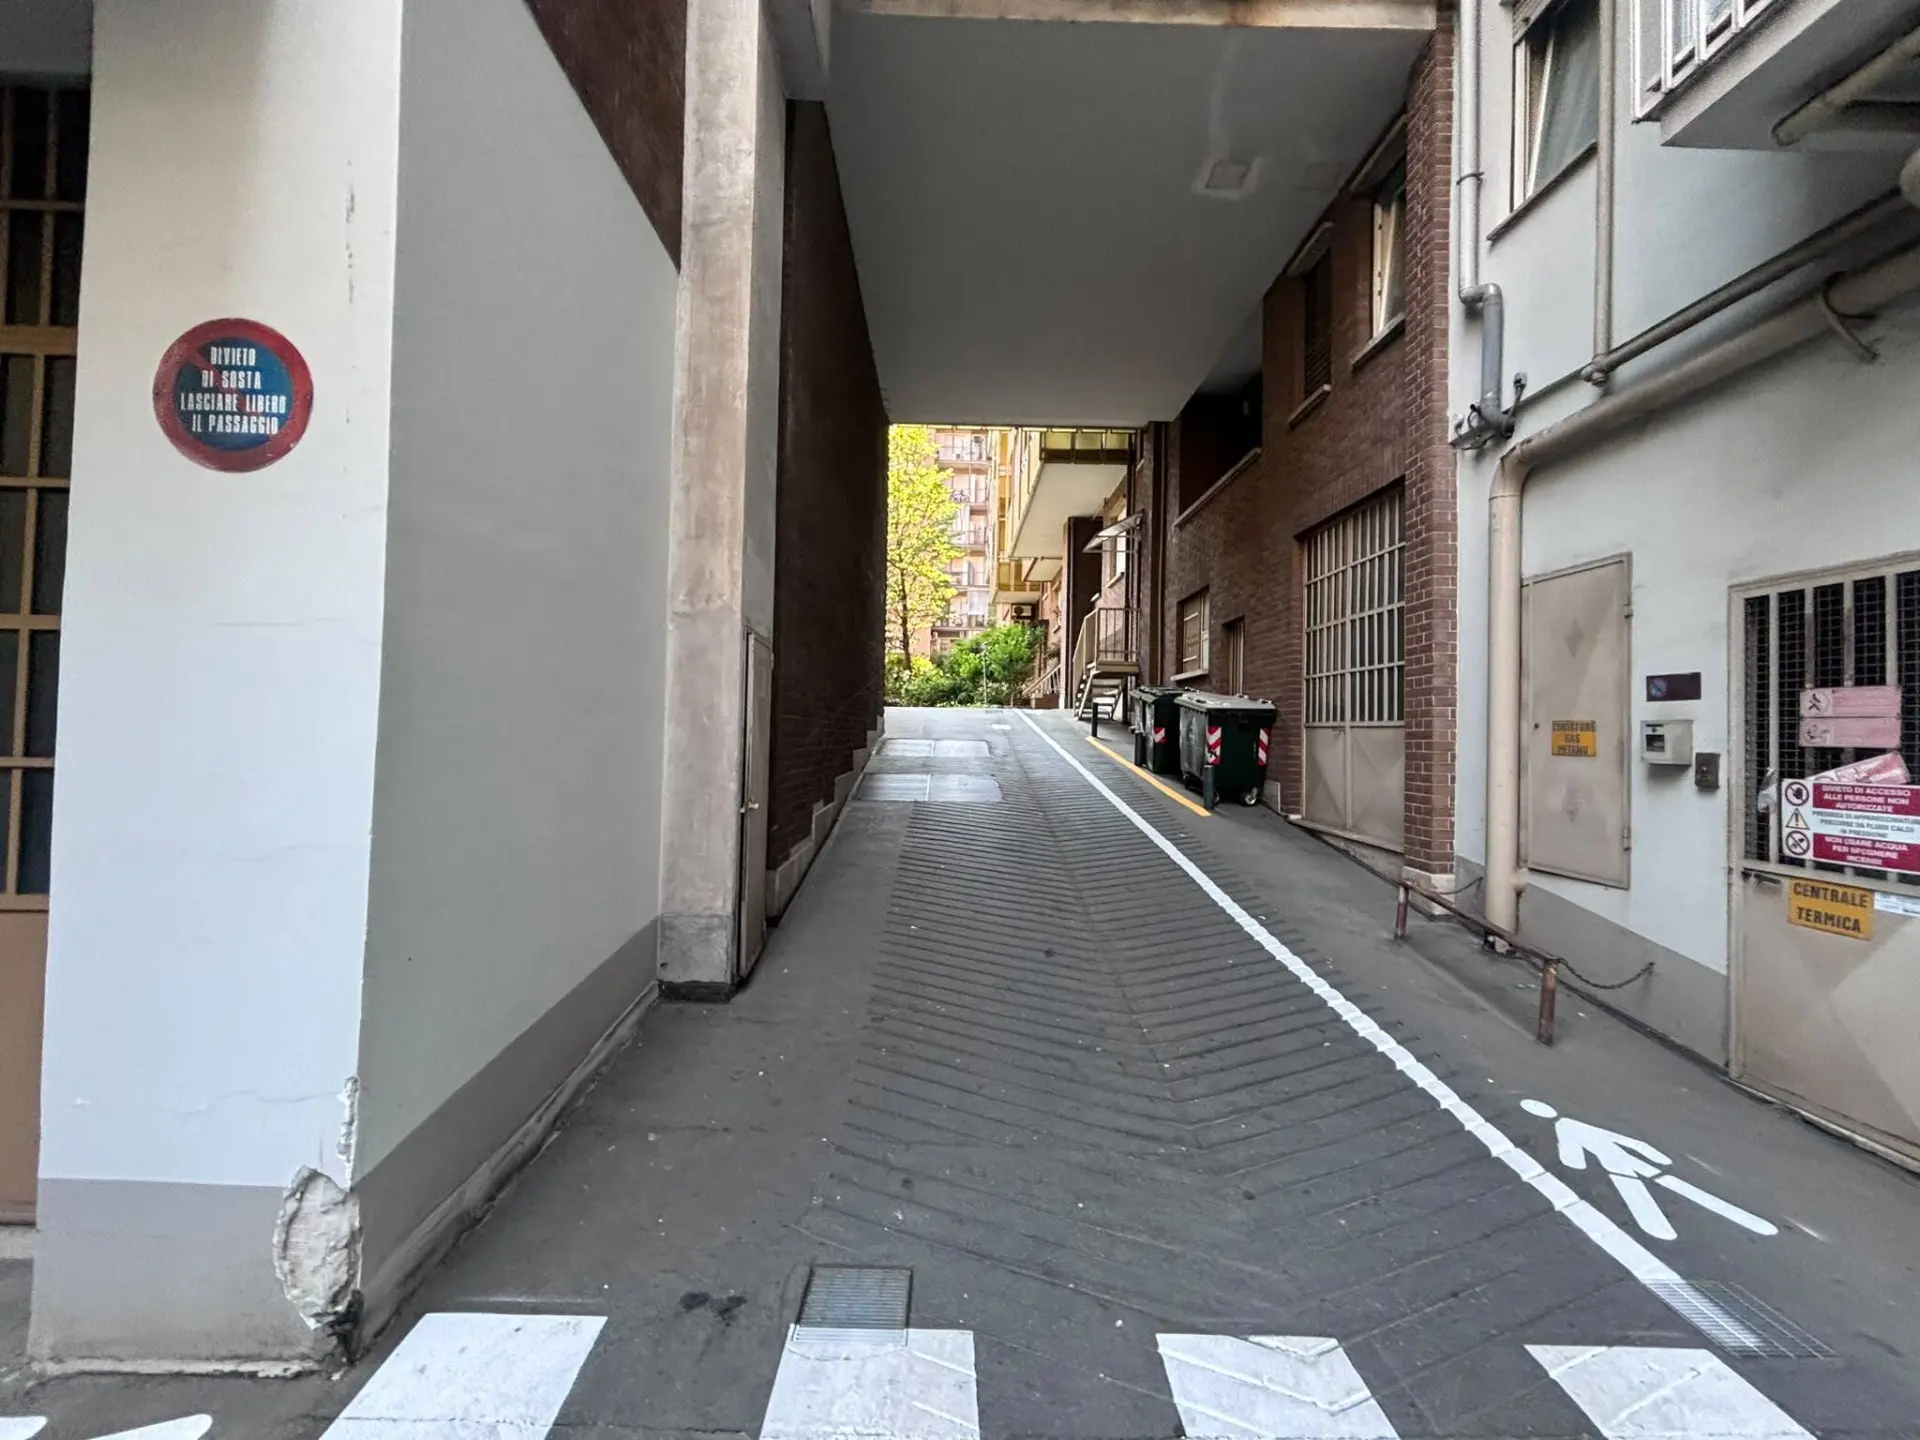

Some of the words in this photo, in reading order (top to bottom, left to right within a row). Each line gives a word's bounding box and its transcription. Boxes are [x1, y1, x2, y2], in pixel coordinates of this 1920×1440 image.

[210, 346, 257, 366] DIVIETO
[201, 370, 213, 388] DI
[221, 371, 262, 390] SOSTA
[180, 393, 238, 412] LASCIARE
[245, 395, 287, 413] LIBERO
[191, 414, 202, 433] IL
[208, 415, 280, 435] PASSAGGIO
[1822, 785, 1853, 793] DIVIETO
[1854, 786, 1863, 794] DI
[1865, 787, 1911, 797] ACCESSO
[1823, 793, 1843, 801] ALLE
[1844, 794, 1885, 804] PERSONE
[1887, 797, 1909, 805] NON
[1835, 802, 1894, 813] AUTORIZZATE
[1890, 824, 1914, 833] CALDI
[1824, 836, 1843, 844] NON
[1844, 838, 1874, 847] USARE
[1875, 841, 1909, 851] ACQUA
[1832, 844, 1849, 853] PER
[1793, 881, 1868, 908] CENTRALE
[1797, 906, 1861, 933] TERMICA
